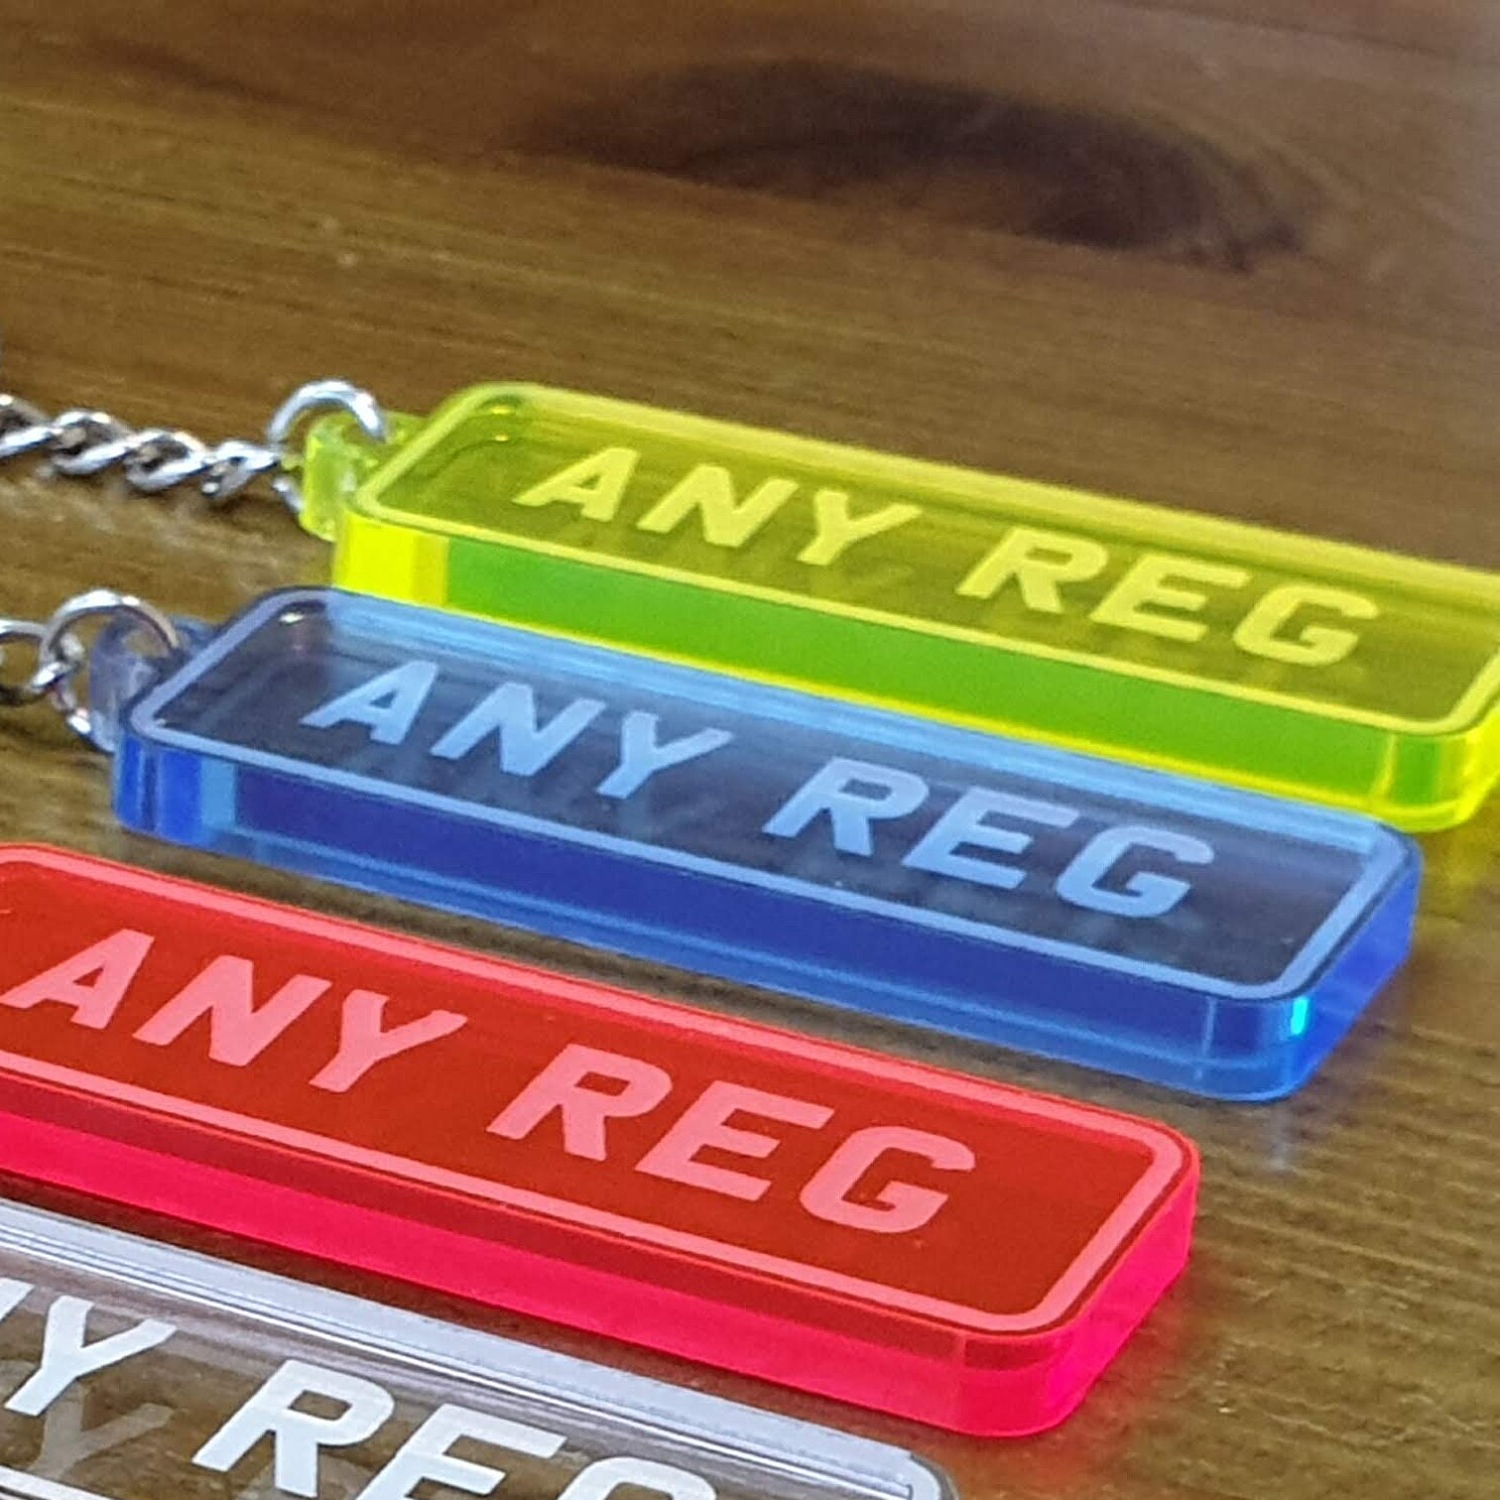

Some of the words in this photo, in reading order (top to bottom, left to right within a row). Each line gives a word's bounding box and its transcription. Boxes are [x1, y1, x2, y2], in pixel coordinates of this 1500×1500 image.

[514, 446, 921, 566] ANY
[957, 526, 1376, 666] REG
[303, 660, 731, 799] ANY
[763, 757, 1214, 919] REG
[486, 1043, 976, 1235] REG
